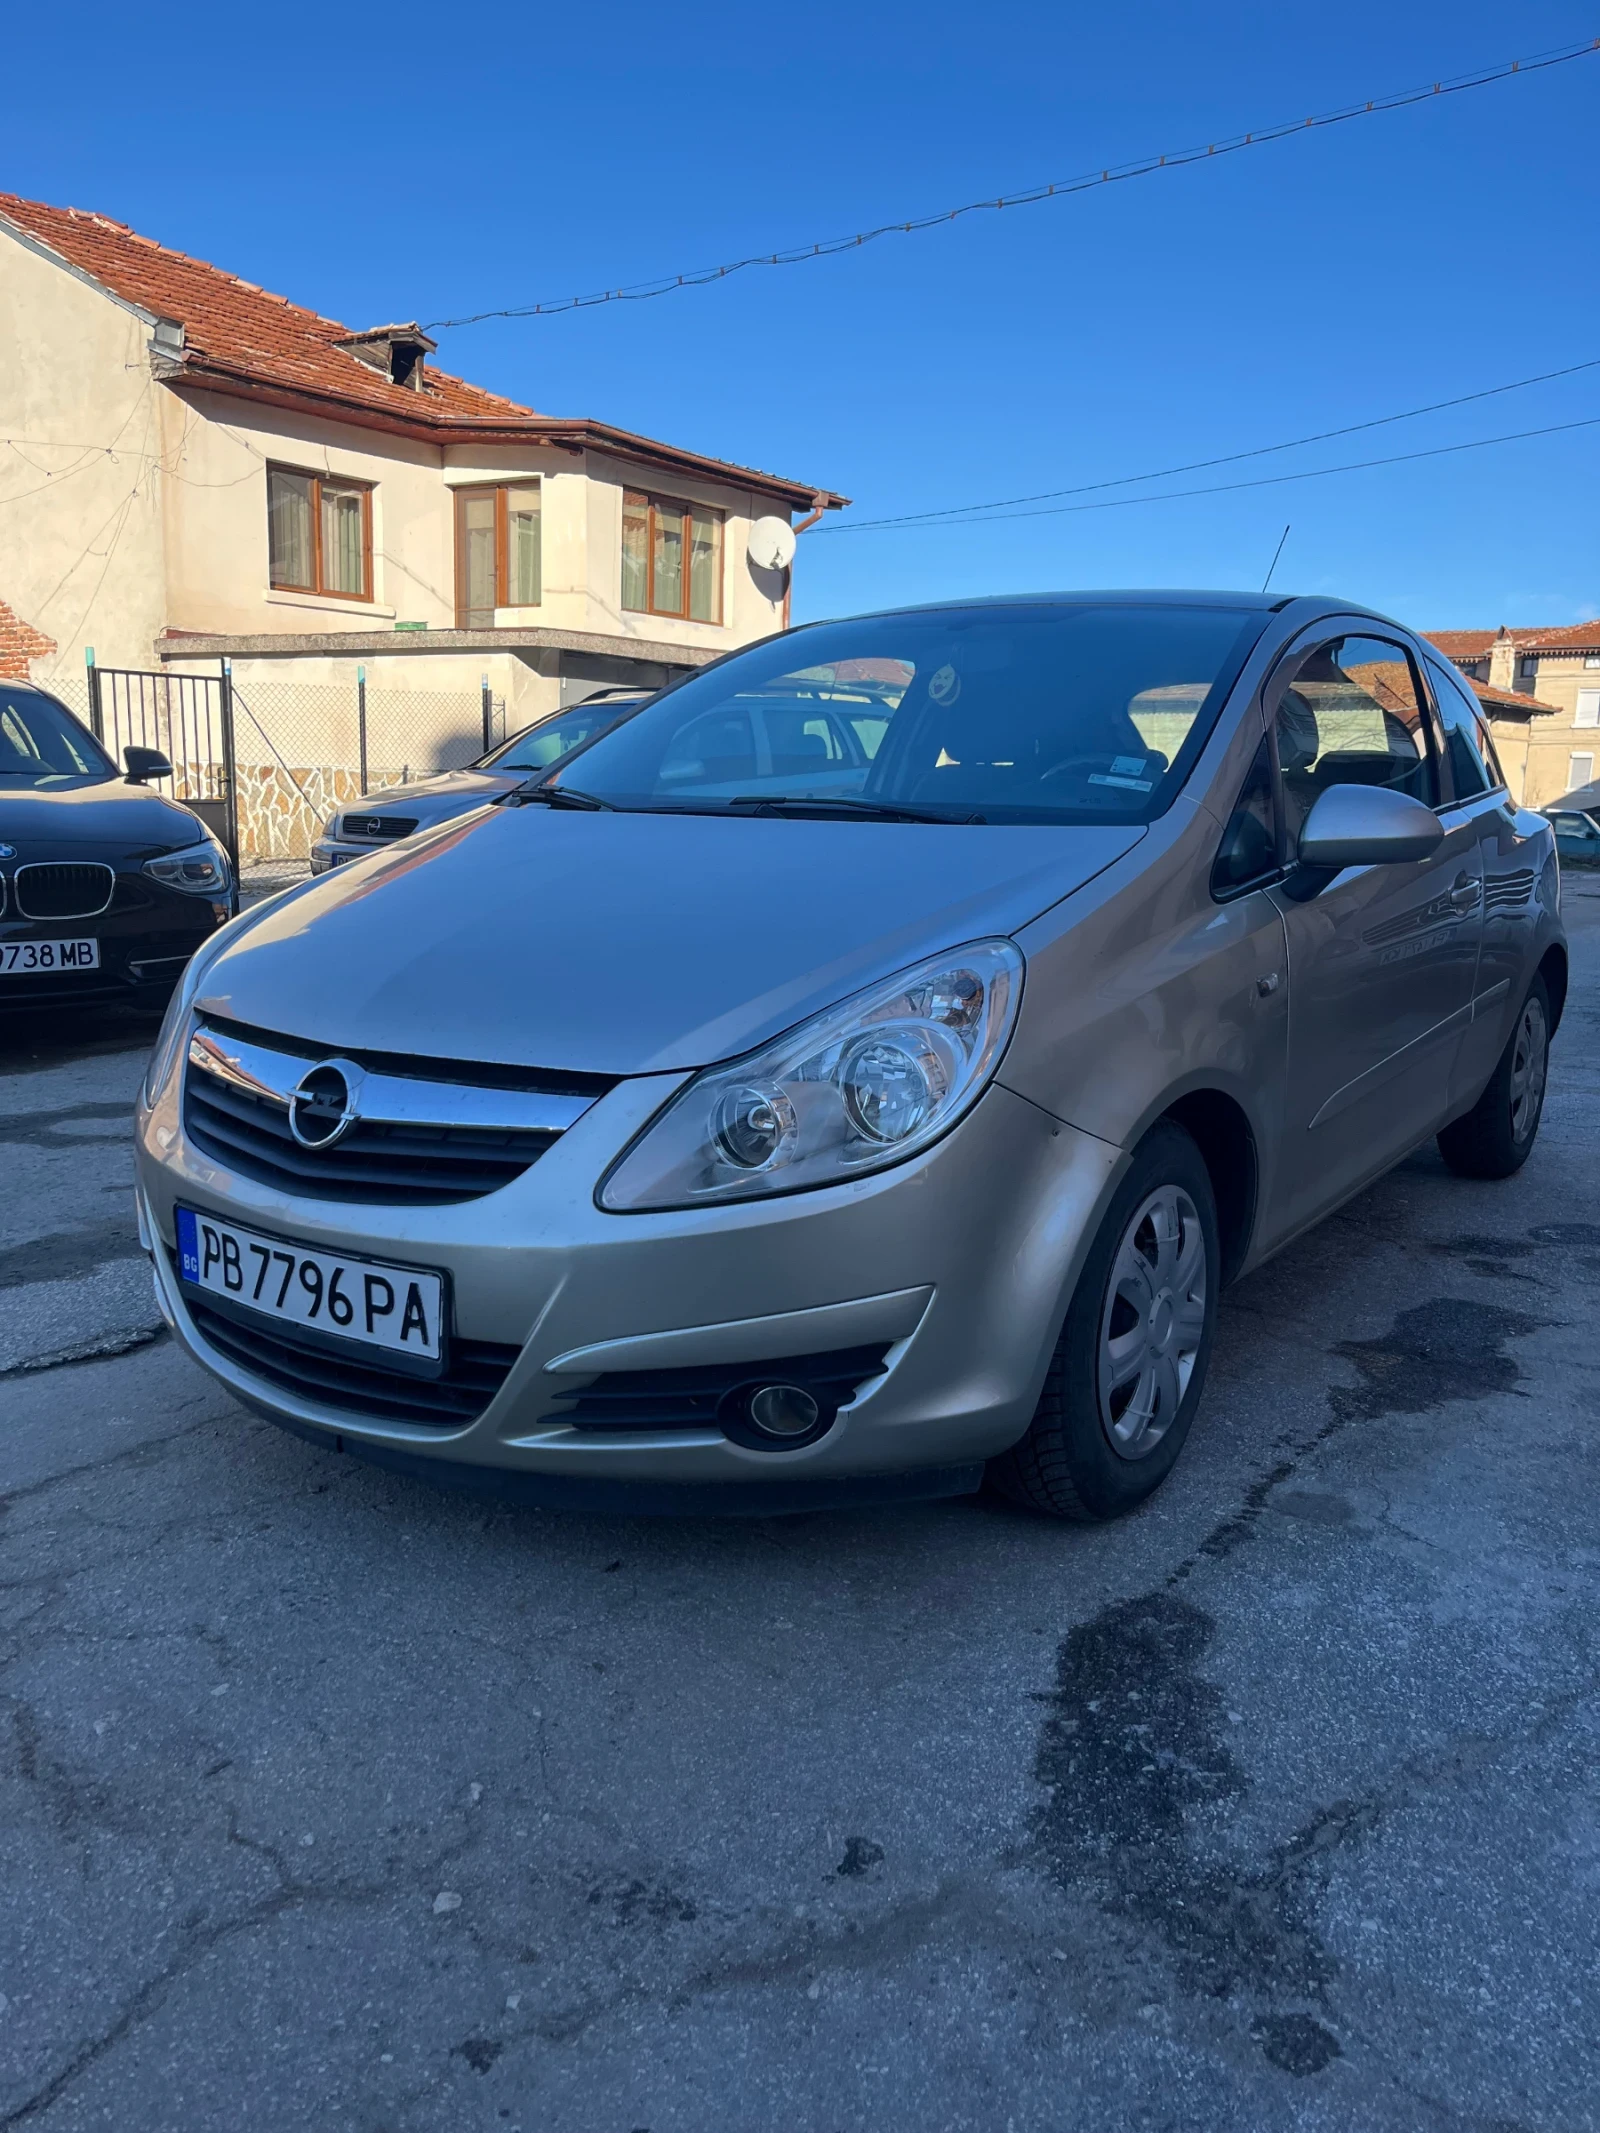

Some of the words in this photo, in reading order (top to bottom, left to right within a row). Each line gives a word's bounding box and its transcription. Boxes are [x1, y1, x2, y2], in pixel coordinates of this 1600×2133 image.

[60, 942, 93, 966] MB
[183, 1254, 198, 1273] BG
[202, 1224, 243, 1292] PB
[249, 1243, 354, 1326] 7796
[364, 1273, 430, 1347] PA
